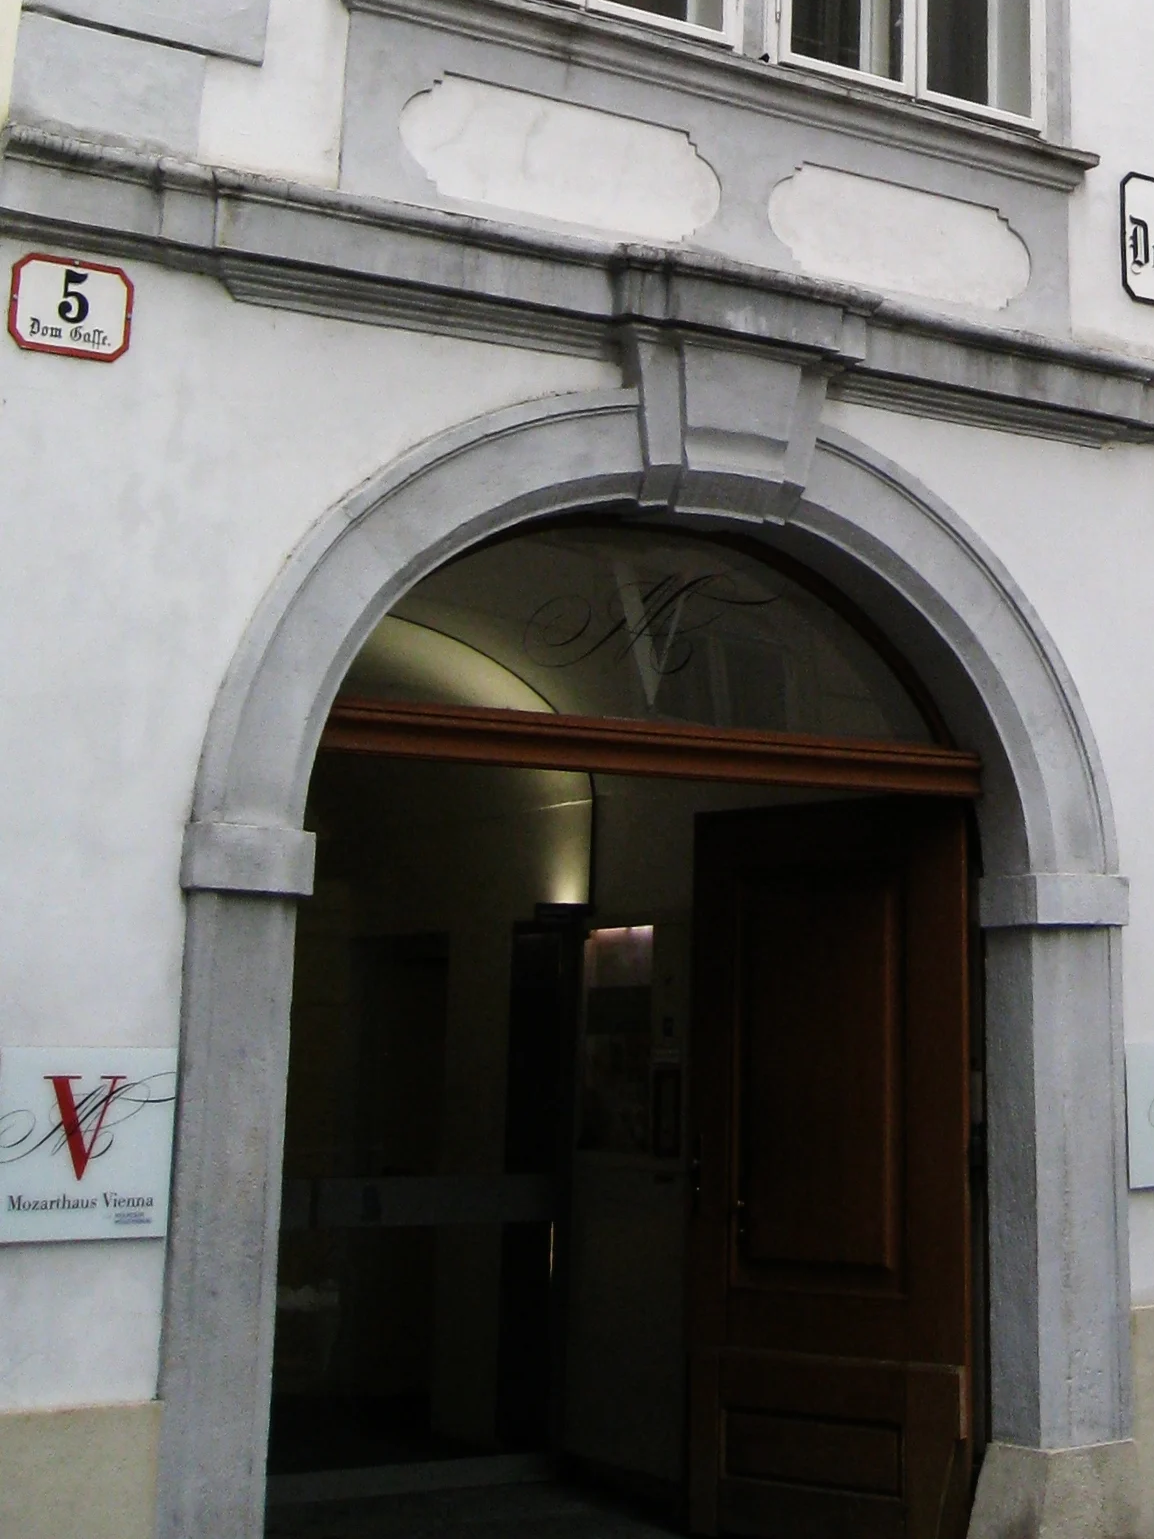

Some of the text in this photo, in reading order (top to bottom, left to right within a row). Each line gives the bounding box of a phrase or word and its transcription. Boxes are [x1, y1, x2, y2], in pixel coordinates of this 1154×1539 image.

[58, 269, 89, 324] 5
[29, 317, 62, 339] Dom
[8, 1191, 154, 1211] Mozarthaus Vienna
